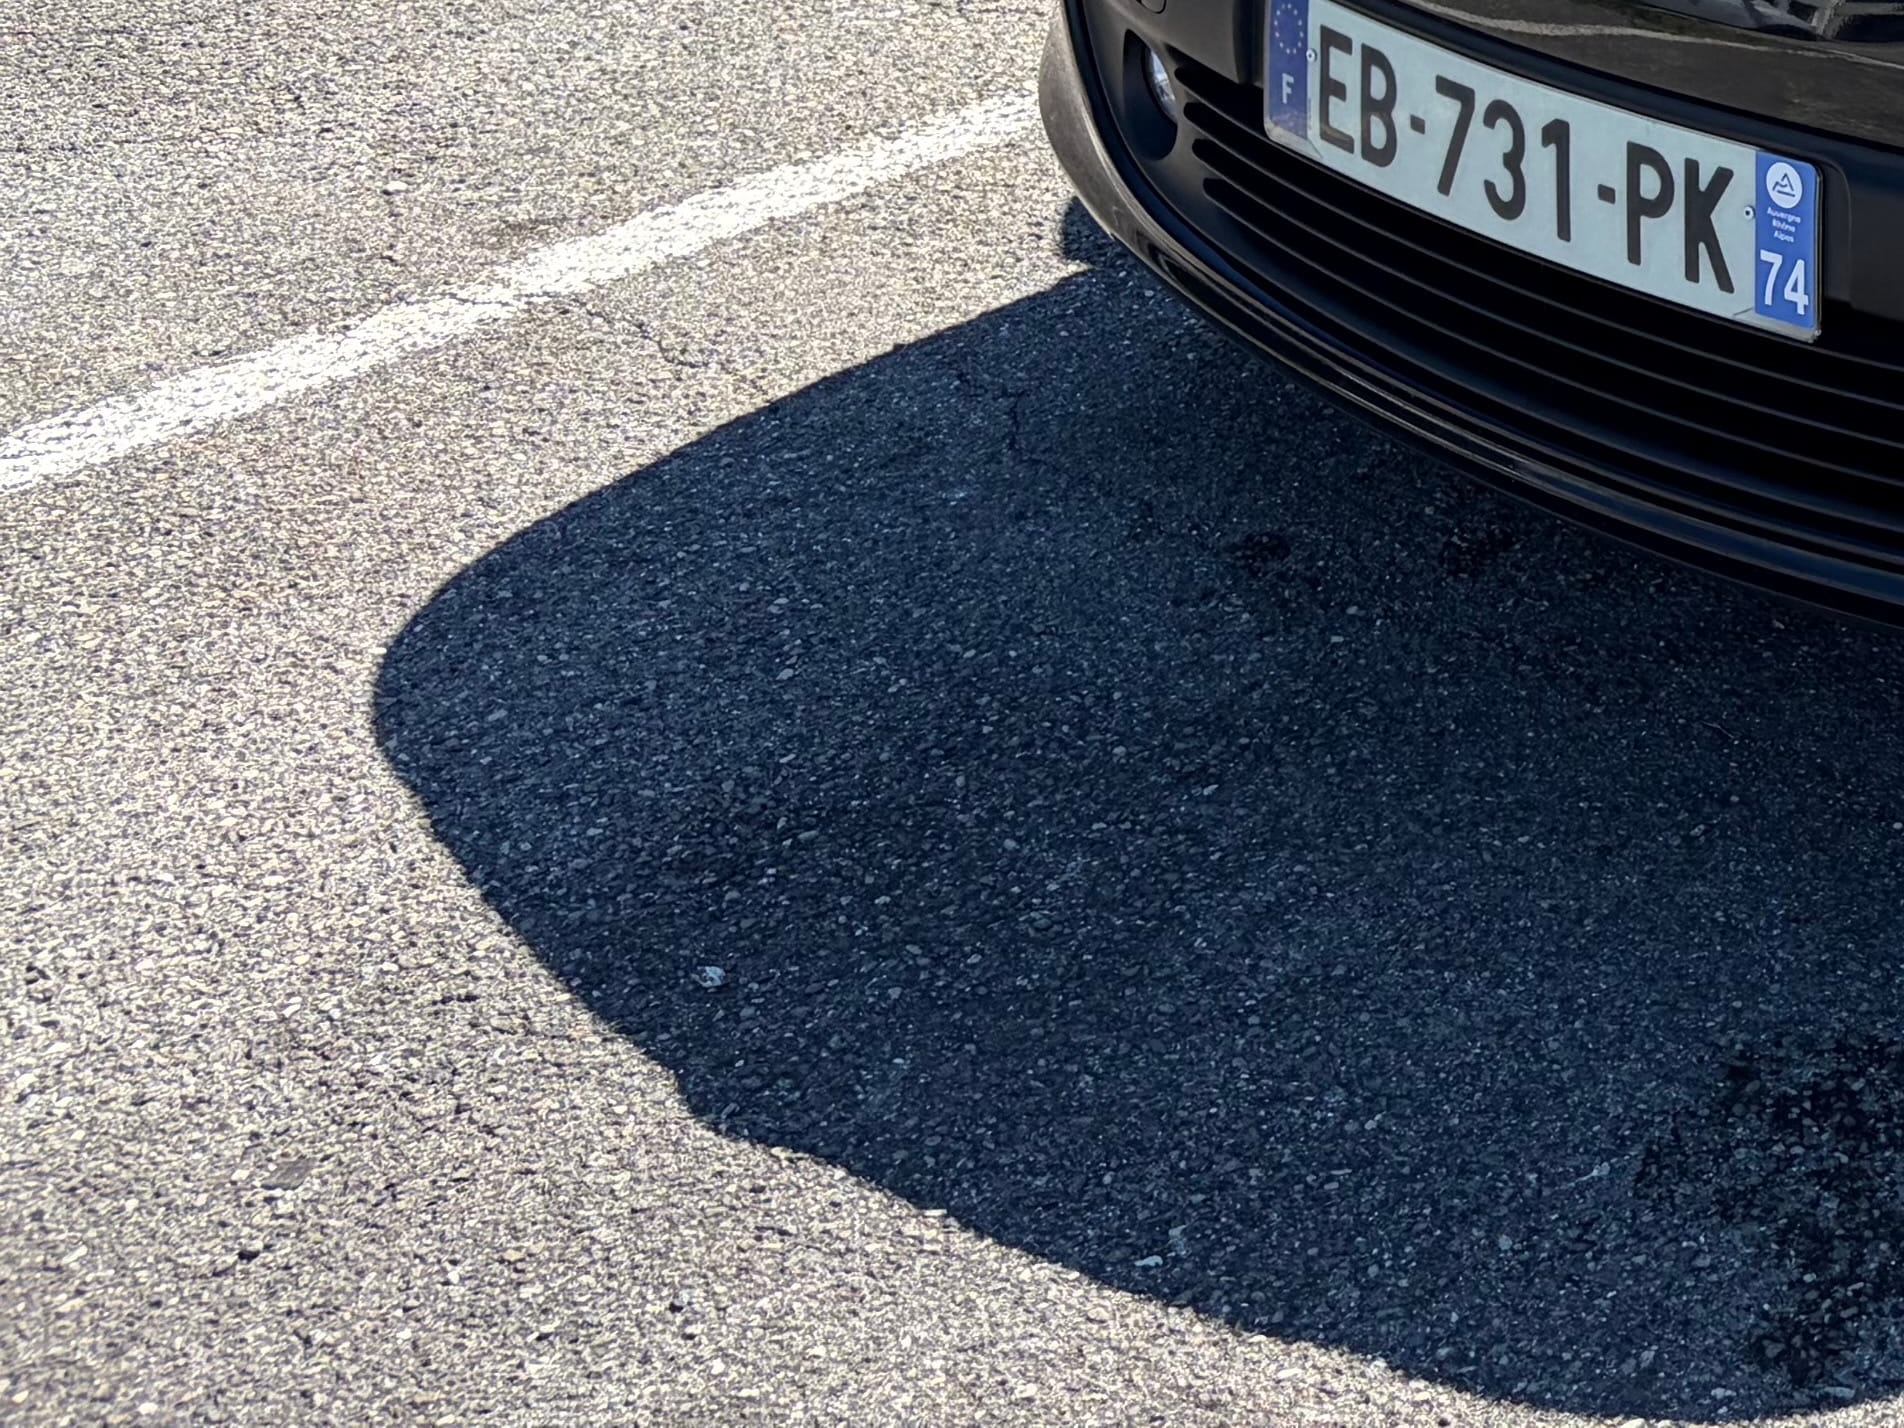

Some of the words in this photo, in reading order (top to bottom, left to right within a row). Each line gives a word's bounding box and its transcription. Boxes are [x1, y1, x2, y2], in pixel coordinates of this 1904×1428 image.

[1281, 72, 1295, 105] F
[1317, 24, 1736, 296] EB-731-PK
[1767, 207, 1801, 223] Auvergne
[1774, 230, 1794, 243] Alpes
[1759, 248, 1809, 316] 74
